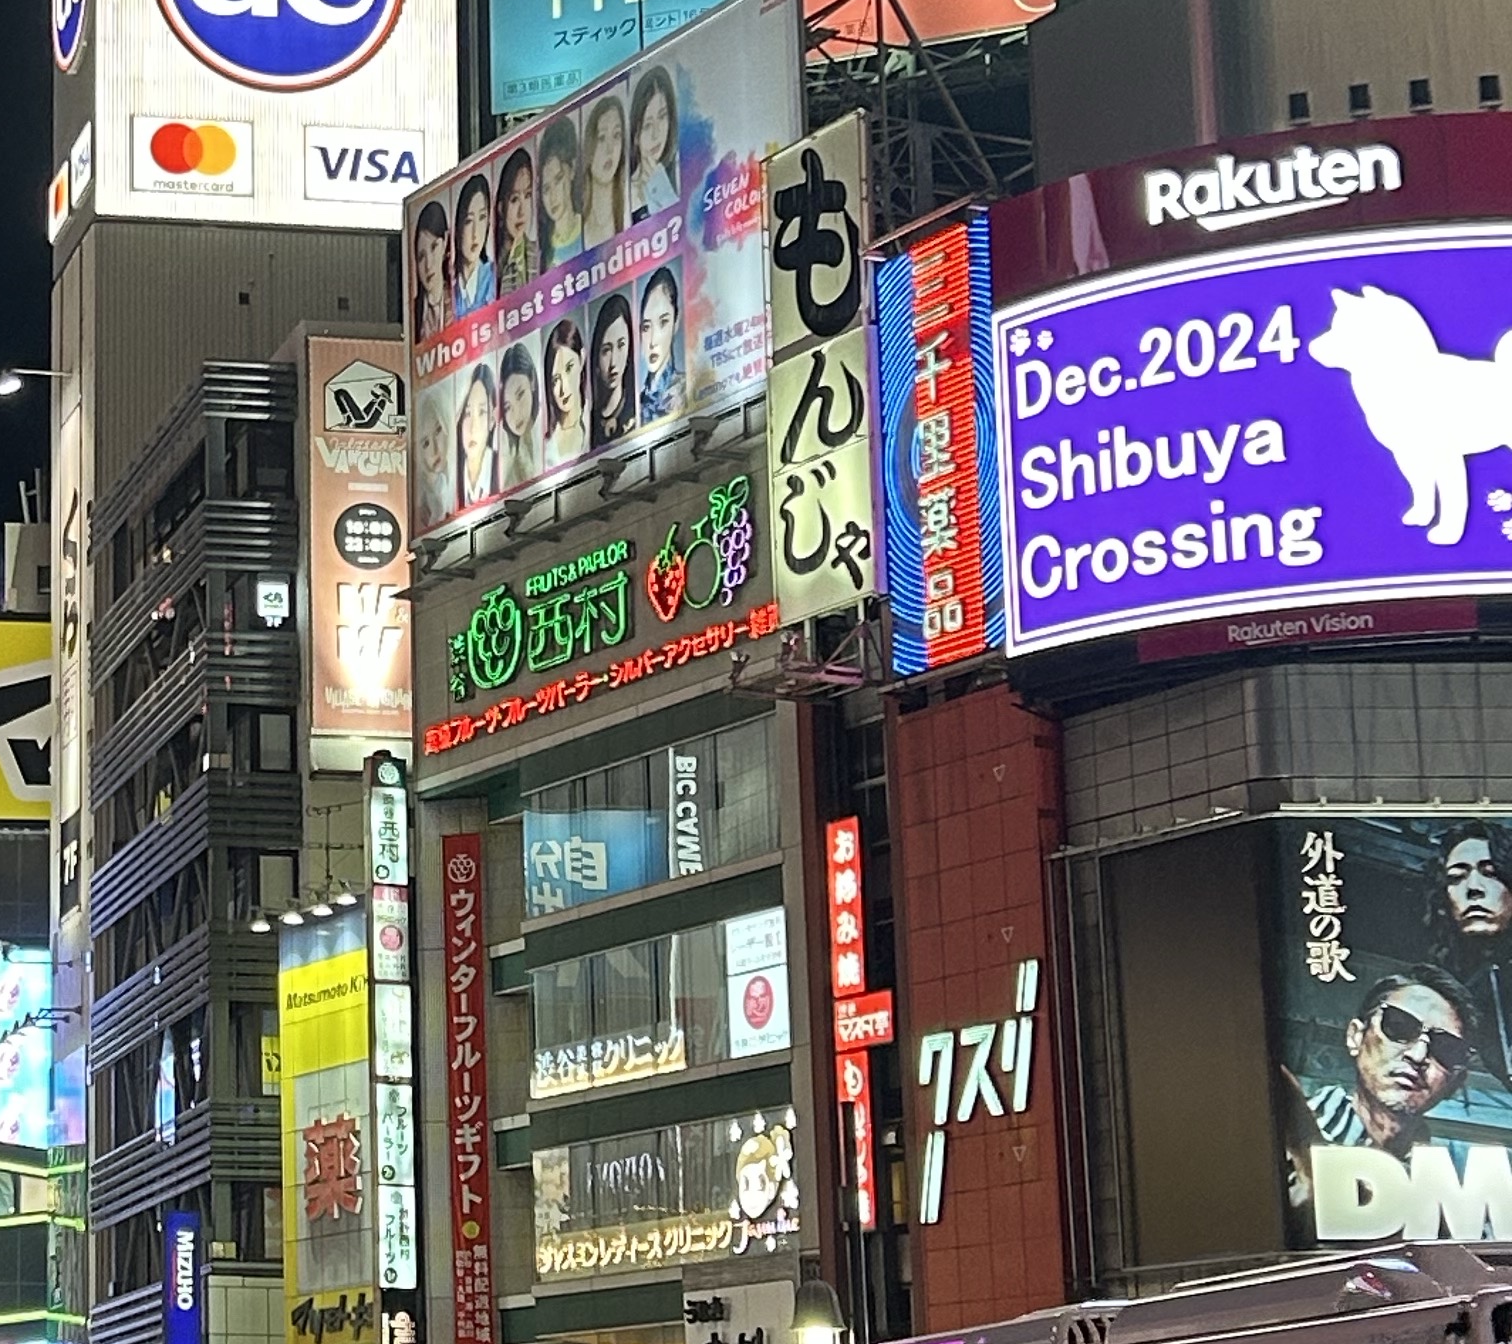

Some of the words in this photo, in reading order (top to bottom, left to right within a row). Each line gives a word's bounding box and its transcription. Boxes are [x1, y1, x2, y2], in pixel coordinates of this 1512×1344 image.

[553, 16, 636, 50] スティック
[152, 177, 235, 193] mastercard
[310, 145, 421, 185] VISA
[703, 171, 750, 212] SEVEN
[1143, 143, 1402, 230] Rakuten
[415, 334, 466, 378] Who
[471, 317, 493, 350] is
[498, 294, 544, 336] last
[550, 216, 684, 306] standing?
[772, 147, 872, 590] もんじゃ
[1014, 305, 1301, 419] Dec.2024
[1019, 418, 1286, 509] Shibuya
[1021, 500, 1324, 599] Crossing
[527, 570, 630, 674] 西村
[1226, 615, 1306, 644] Rakuten
[1310, 611, 1374, 637] Vision
[1300, 830, 1356, 983] 外道の歌
[285, 982, 349, 1011] Matsumoto
[447, 889, 485, 1215] ウィンターフルーツギフト
[176, 1229, 194, 1312] MIZUHO
